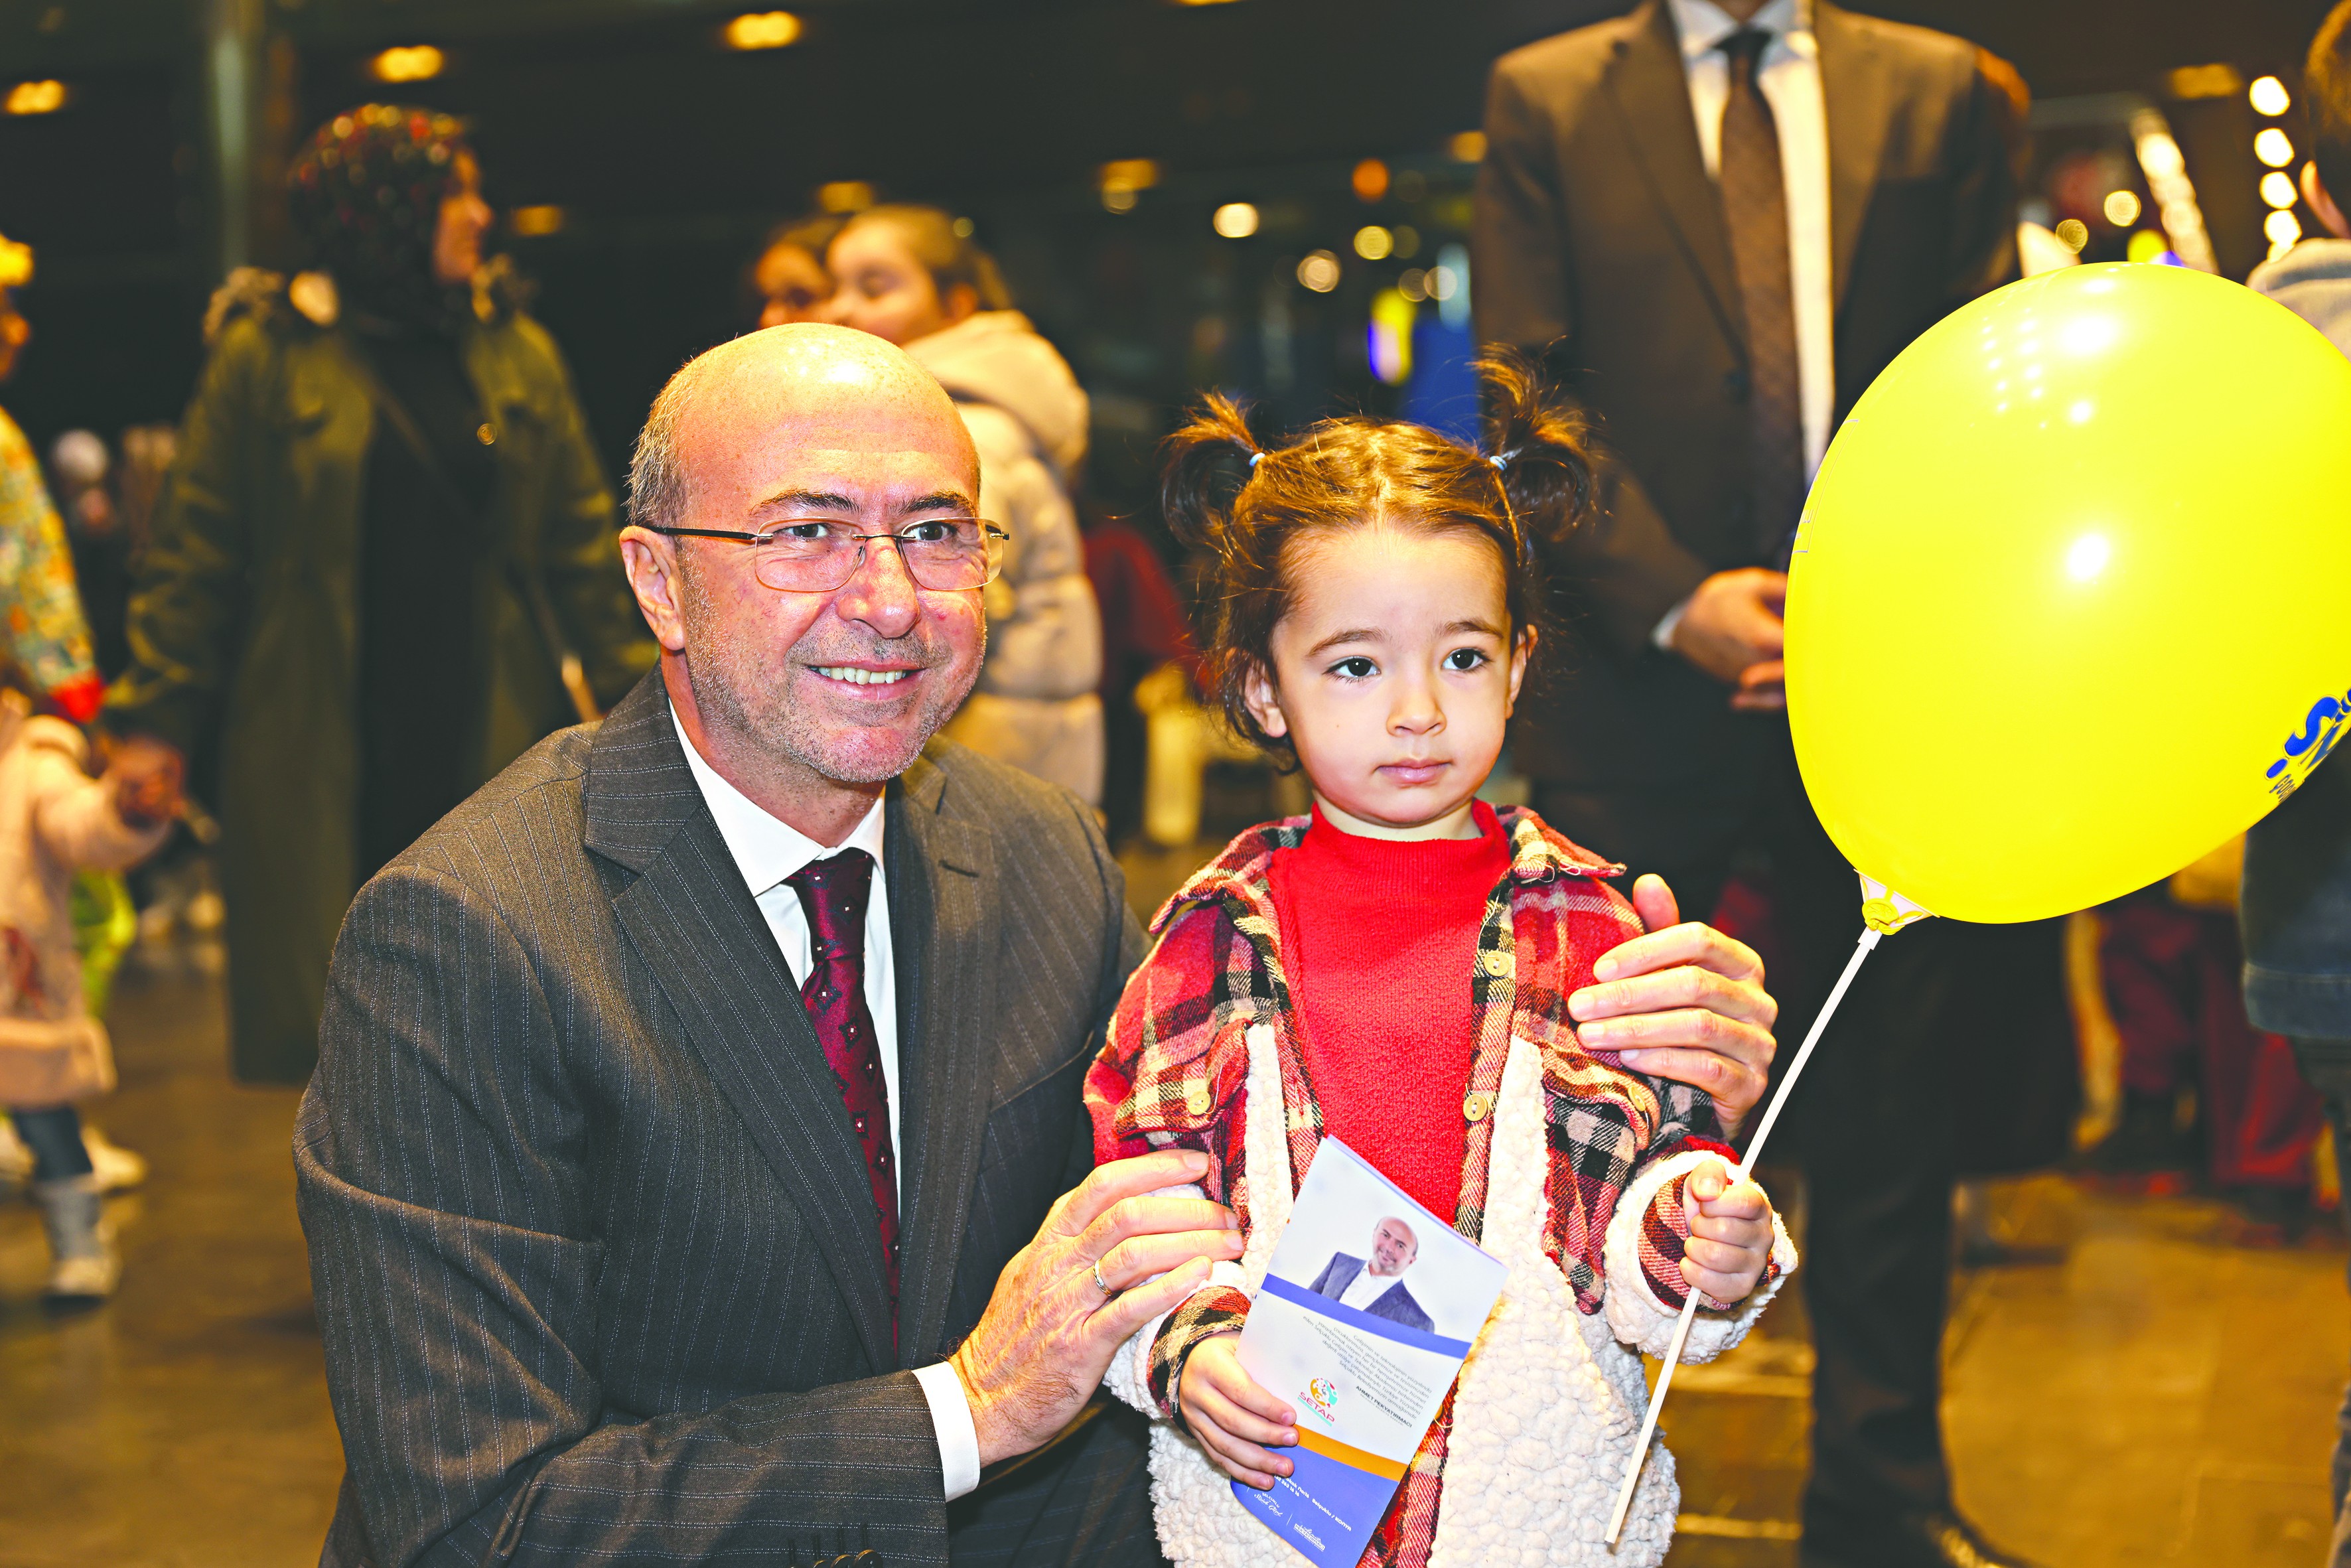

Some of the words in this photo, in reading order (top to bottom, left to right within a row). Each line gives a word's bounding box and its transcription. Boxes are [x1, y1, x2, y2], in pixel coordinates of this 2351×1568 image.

[1303, 1316, 1314, 1326] eden
[1299, 1391, 1335, 1422] SETAP
[1356, 1386, 1374, 1400] AHMET
[1374, 1399, 1413, 1428] PEKYATIRMACI
[1286, 1478, 1298, 1488] okak
[1334, 1516, 1352, 1532] KONYA
